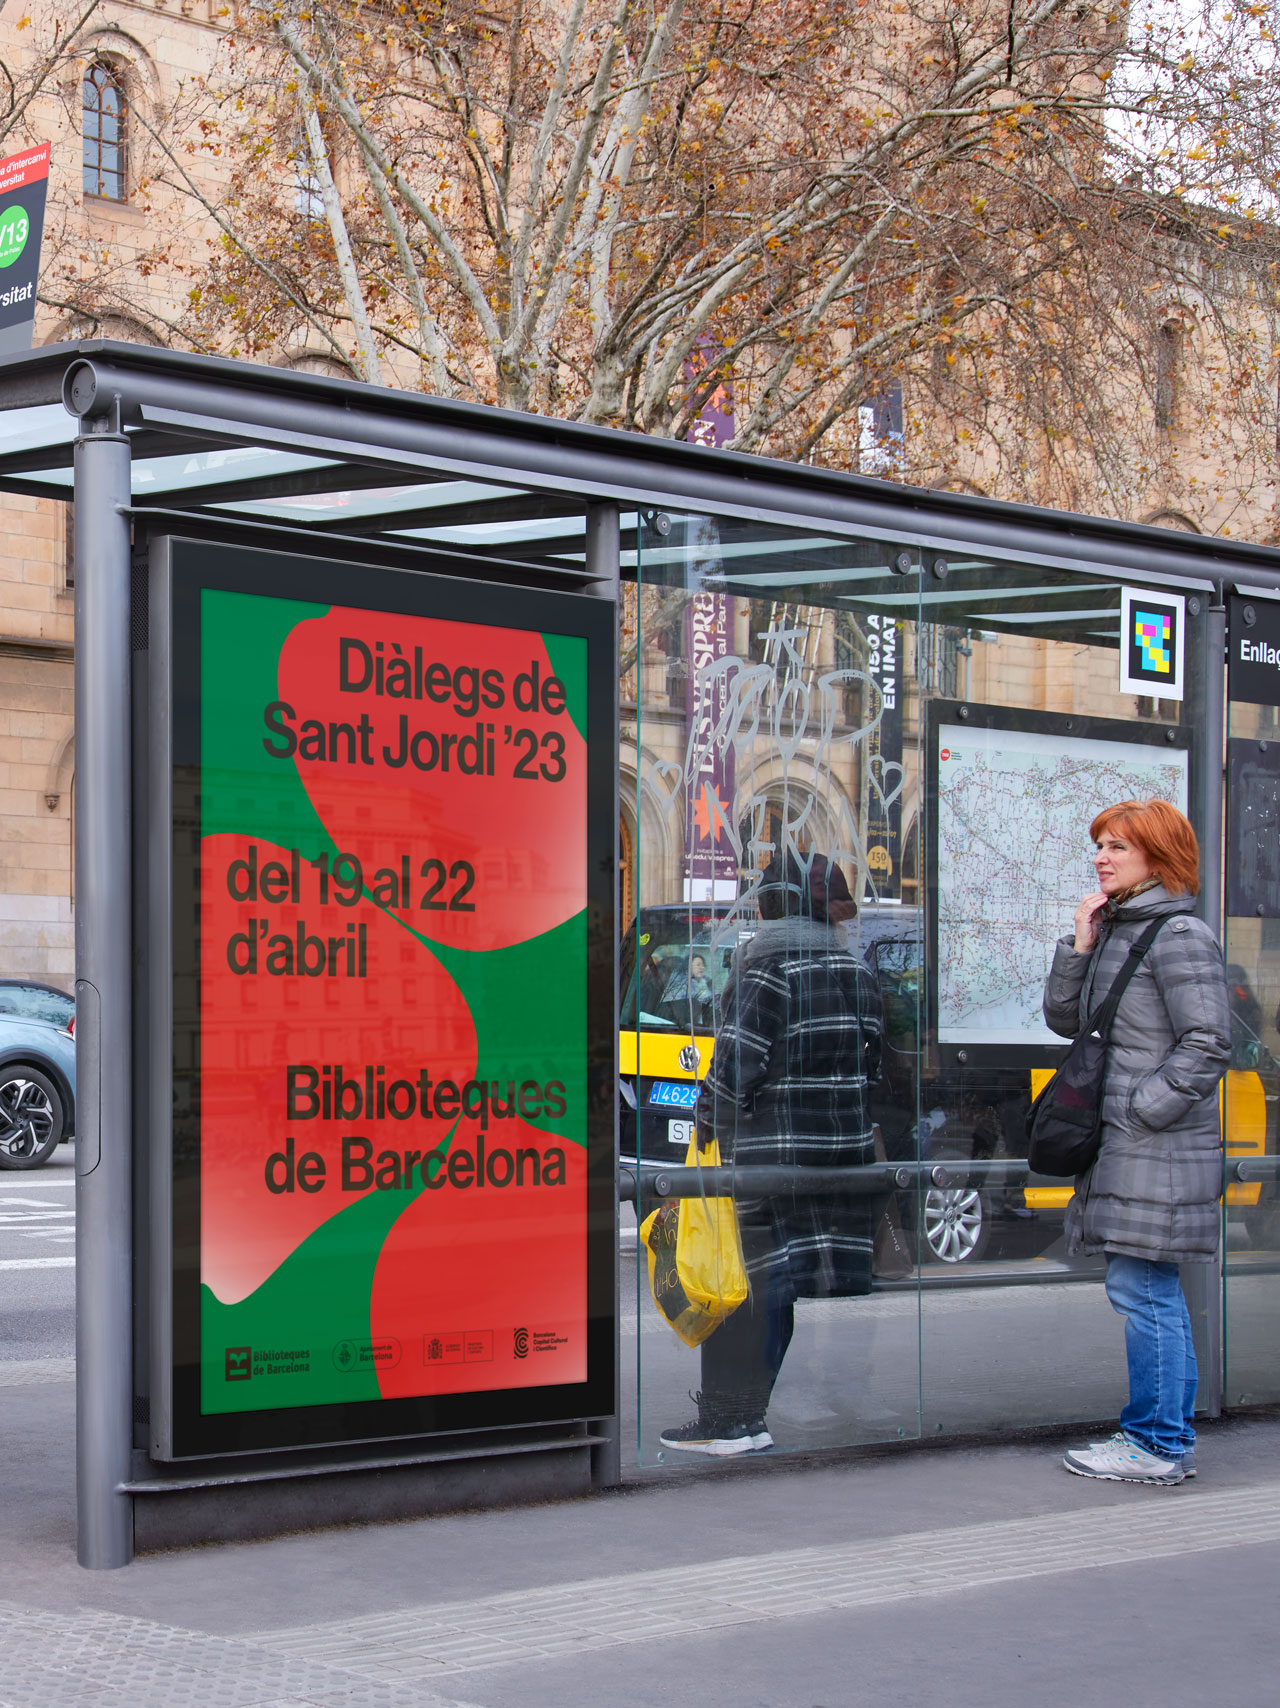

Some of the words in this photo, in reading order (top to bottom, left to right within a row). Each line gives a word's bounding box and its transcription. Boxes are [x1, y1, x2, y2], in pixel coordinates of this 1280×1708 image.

[339, 636, 504, 718] Diàlegs
[512, 660, 567, 716] de
[883, 677, 896, 709] EN
[262, 701, 374, 766] Sant
[382, 714, 495, 776] Jordi
[227, 845, 300, 904] del
[310, 851, 364, 907] 19
[373, 855, 410, 910] al
[419, 858, 476, 912] 22
[871, 851, 886, 863] 150
[286, 1064, 568, 1130] Biblioteques
[264, 1137, 326, 1194] de
[341, 1135, 566, 1191] Barcelona
[253, 1349, 310, 1362] Biblioteques
[253, 1365, 264, 1375] de
[267, 1362, 310, 1374] Barcelona
[360, 1352, 393, 1362] Barcelona
